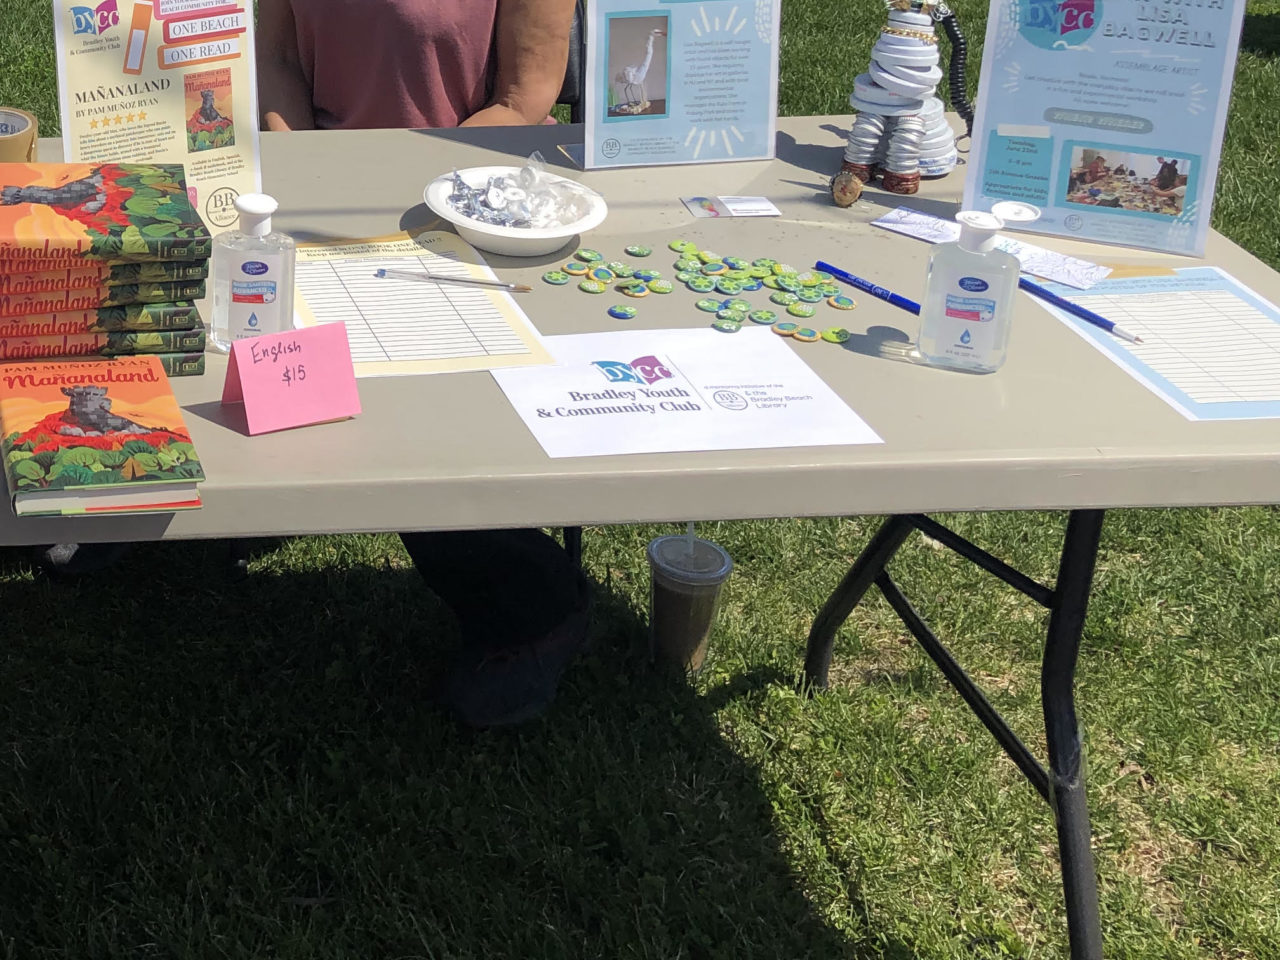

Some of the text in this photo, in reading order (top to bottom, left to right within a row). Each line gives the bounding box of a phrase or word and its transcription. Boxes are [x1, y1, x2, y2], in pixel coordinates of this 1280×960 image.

[70, 8, 120, 34] bycc
[173, 16, 239, 36] ONE BEACH
[1137, 5, 1188, 26] LISA
[1103, 23, 1216, 48] BAGWELL
[171, 43, 231, 62] ONE READ
[75, 78, 170, 105] MAÑANALAND
[76, 98, 159, 118] BY PAM MUÑOZ RYAN
[213, 192, 235, 208] BB
[250, 341, 301, 364] English
[3, 367, 159, 390] Mañanaland
[281, 365, 306, 387] $15
[591, 360, 674, 385] bycc
[568, 387, 690, 403] Bradley Youth
[535, 400, 702, 418] & Community Club
